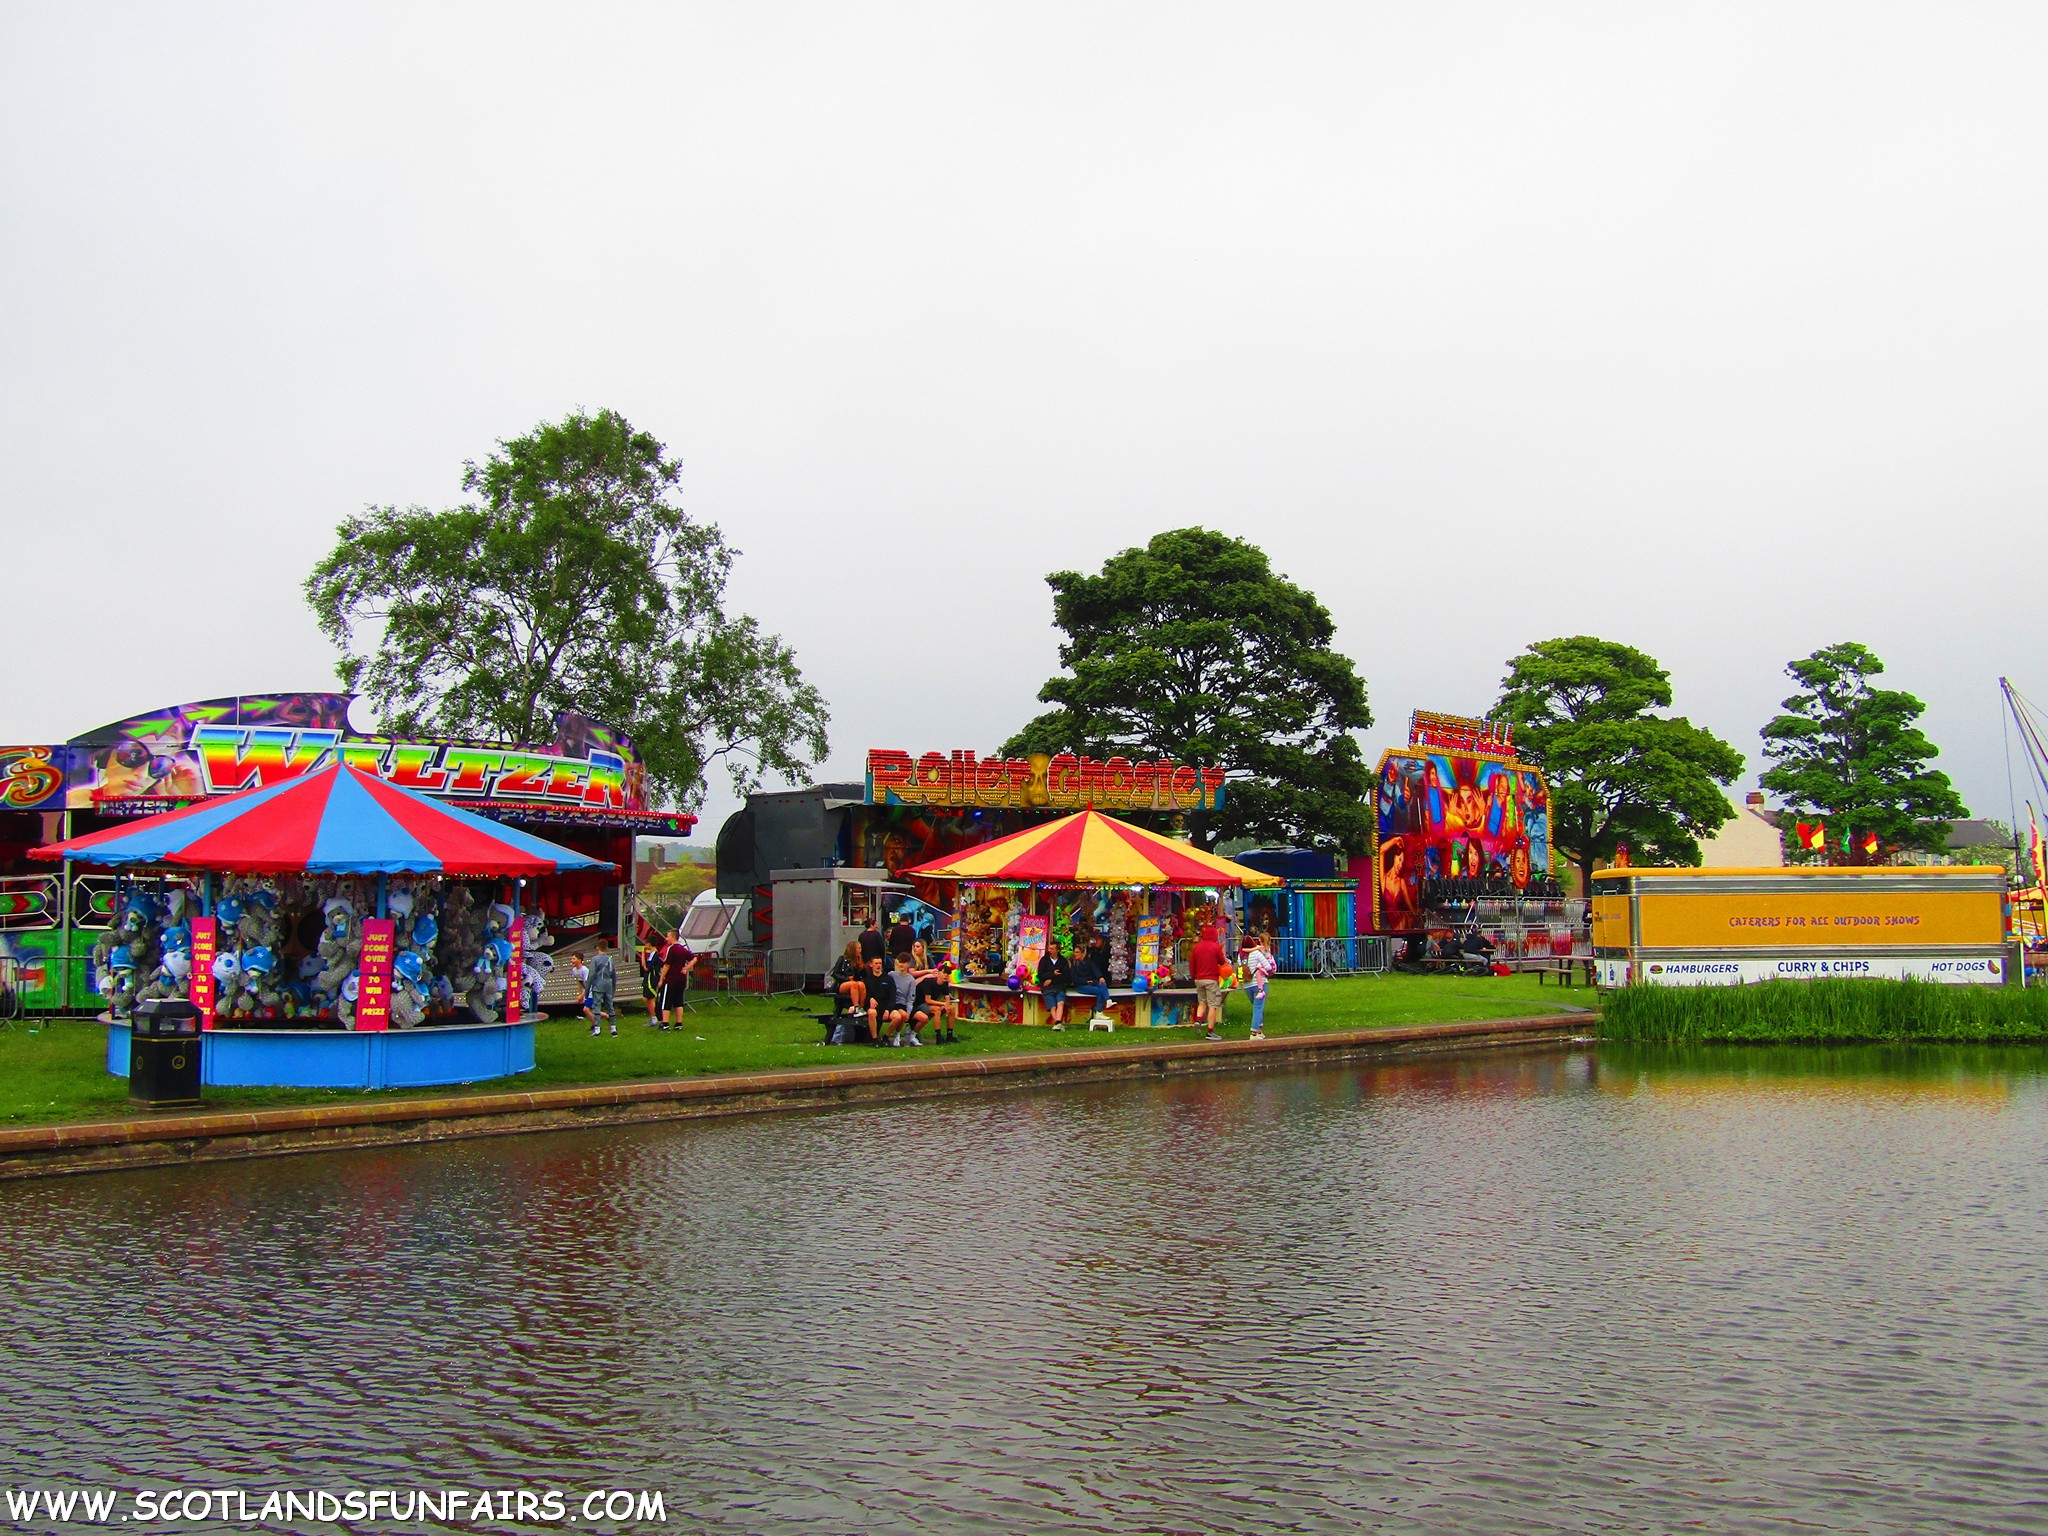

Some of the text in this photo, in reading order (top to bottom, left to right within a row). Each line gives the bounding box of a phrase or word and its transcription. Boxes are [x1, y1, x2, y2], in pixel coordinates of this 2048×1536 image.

[868, 749, 1031, 805] Roller
[1729, 915, 1920, 927] CATERERS FOR ALL OUTDOOR SHOWS
[1665, 964, 1739, 974] HAMBURGERS
[1777, 961, 1869, 972] CURRY & CHIPS
[1931, 962, 1986, 971] HOT DOGS
[370, 997, 376, 1005] A
